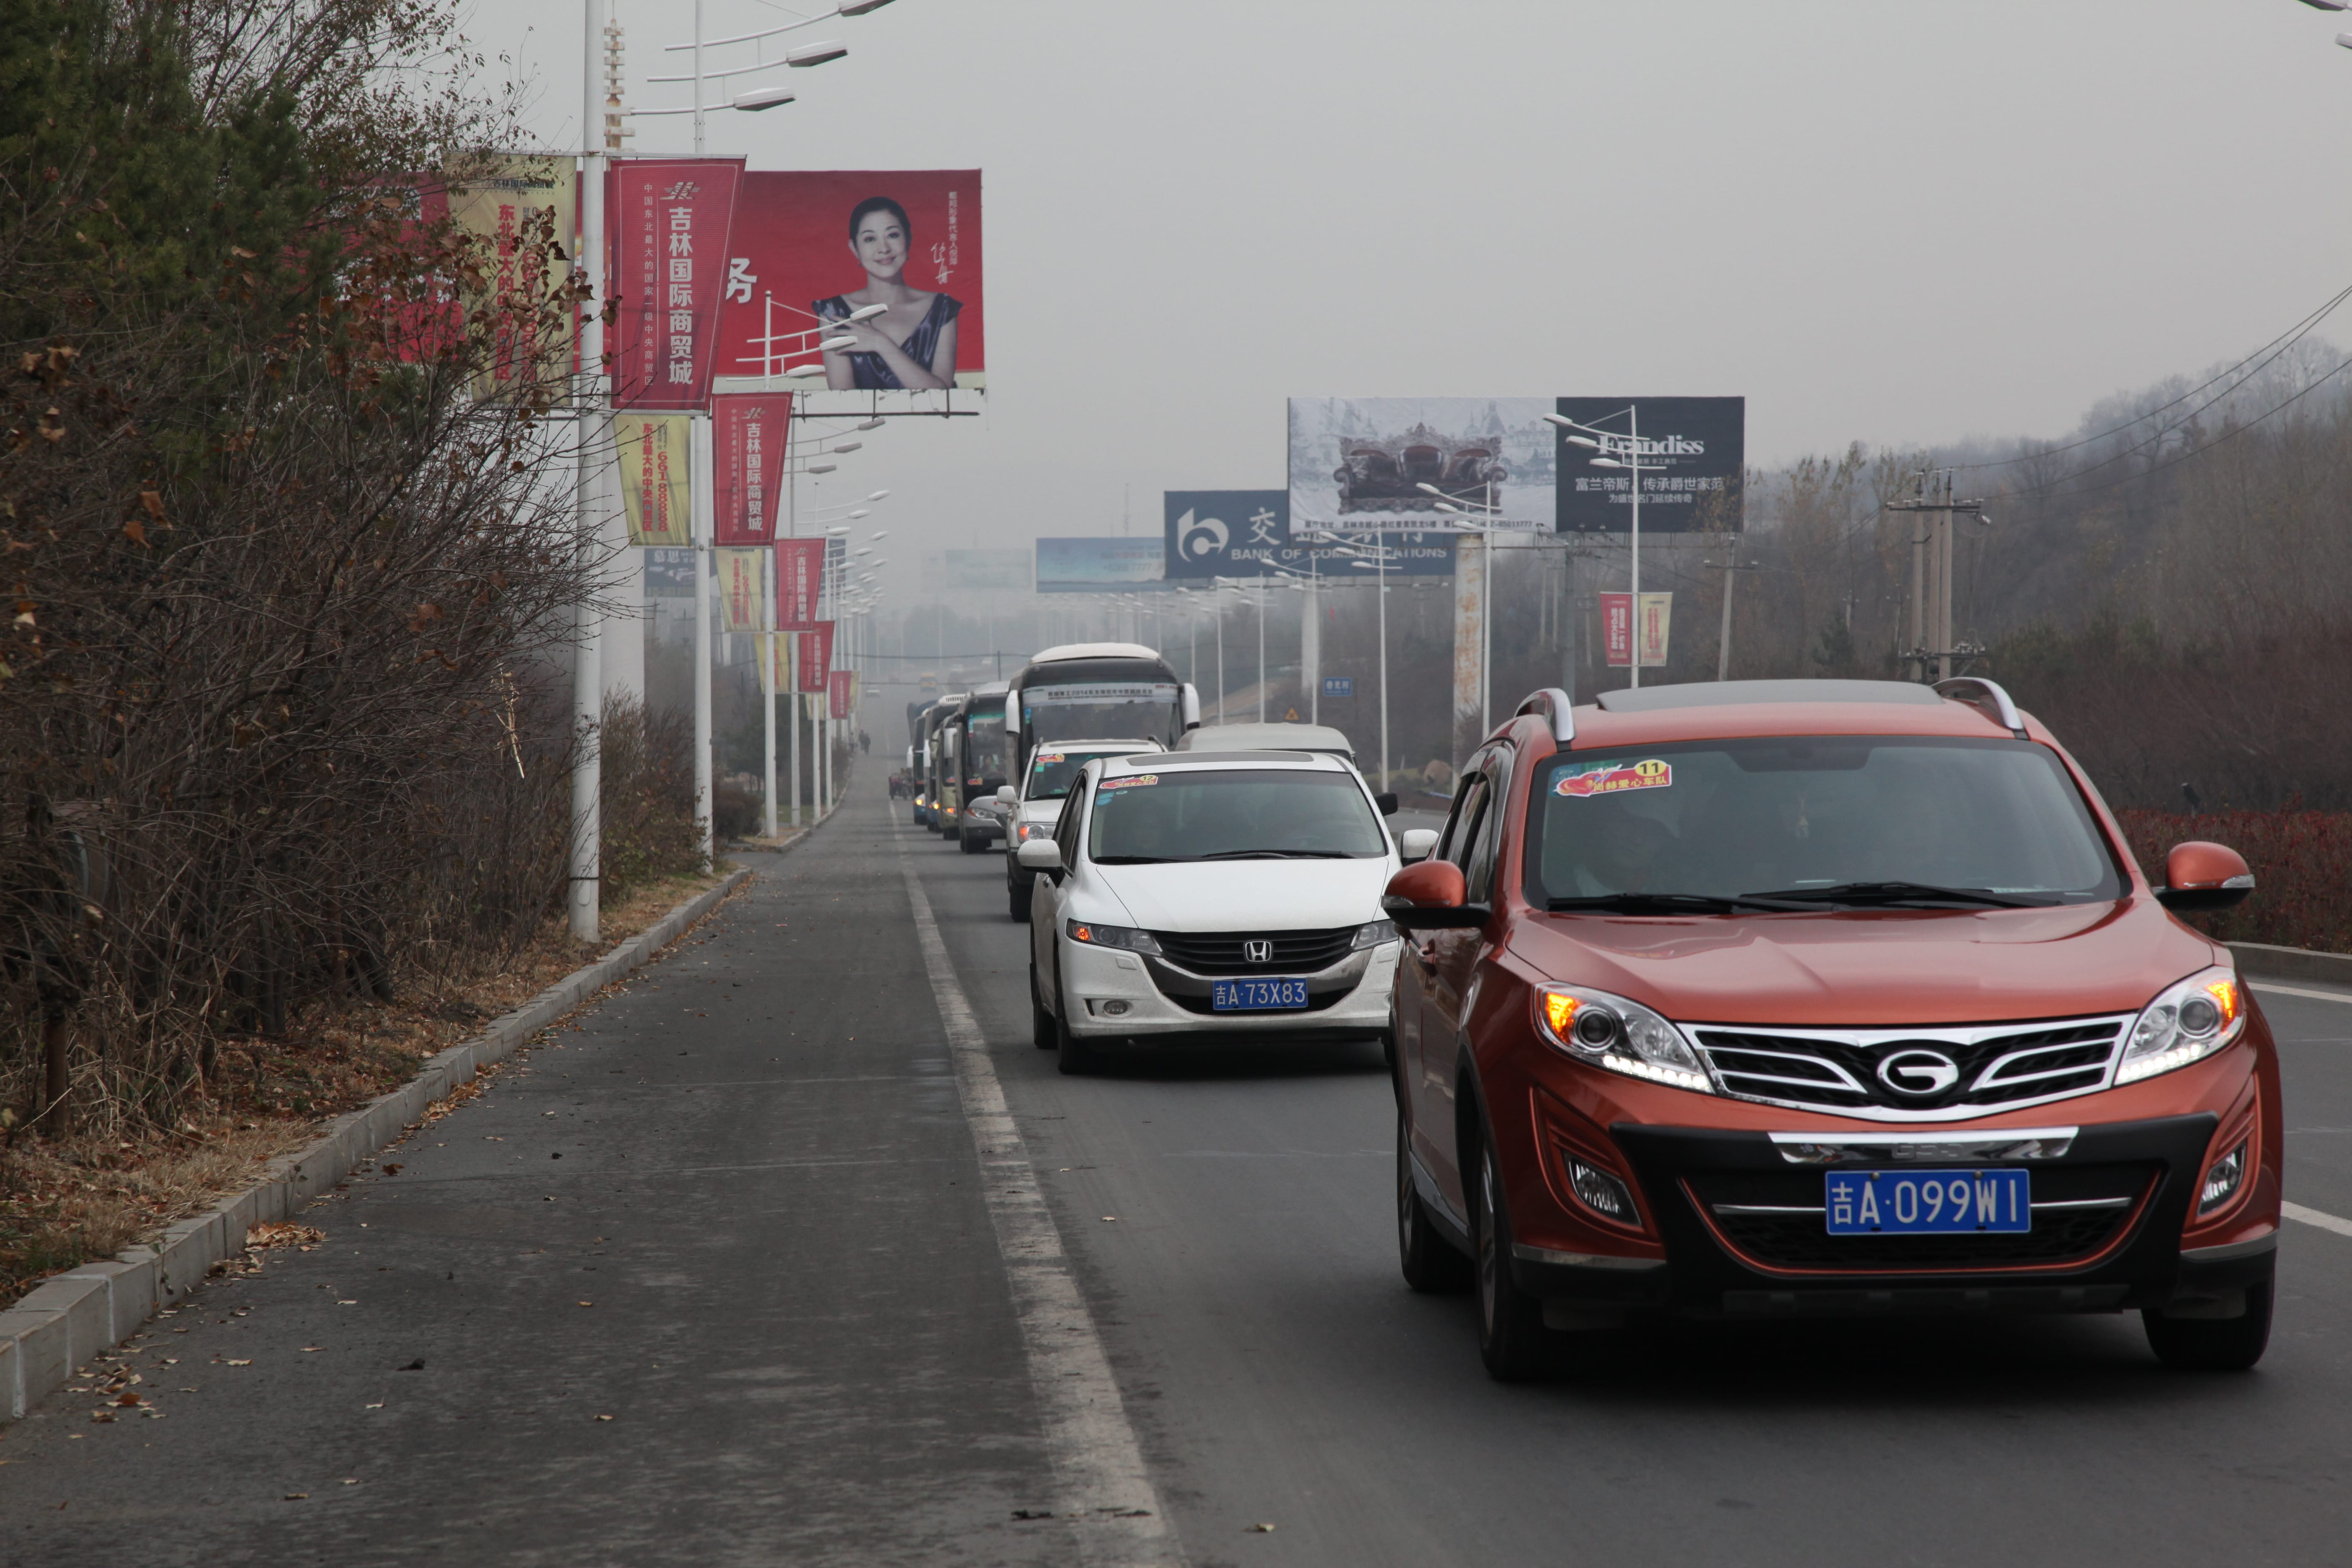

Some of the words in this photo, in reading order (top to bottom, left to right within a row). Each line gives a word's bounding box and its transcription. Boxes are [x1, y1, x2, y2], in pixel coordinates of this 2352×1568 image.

[644, 183, 653, 386] 中国东北最大的国家一级中央商贸区
[668, 206, 693, 385] 吉林国际商贸城
[726, 258, 758, 304] 务
[1597, 435, 1705, 455] Frandiss
[642, 423, 653, 531] 东北最大的中央商贸区
[658, 451, 668, 532] 66188888
[746, 423, 763, 531] 吉林国际商贸城
[1231, 548, 1273, 560] BANK
[1281, 549, 1302, 560] OF
[1593, 776, 1667, 792] 尚赫爱心车队
[1639, 762, 1659, 774] 11
[1215, 982, 1305, 1006] 吉A·73X83
